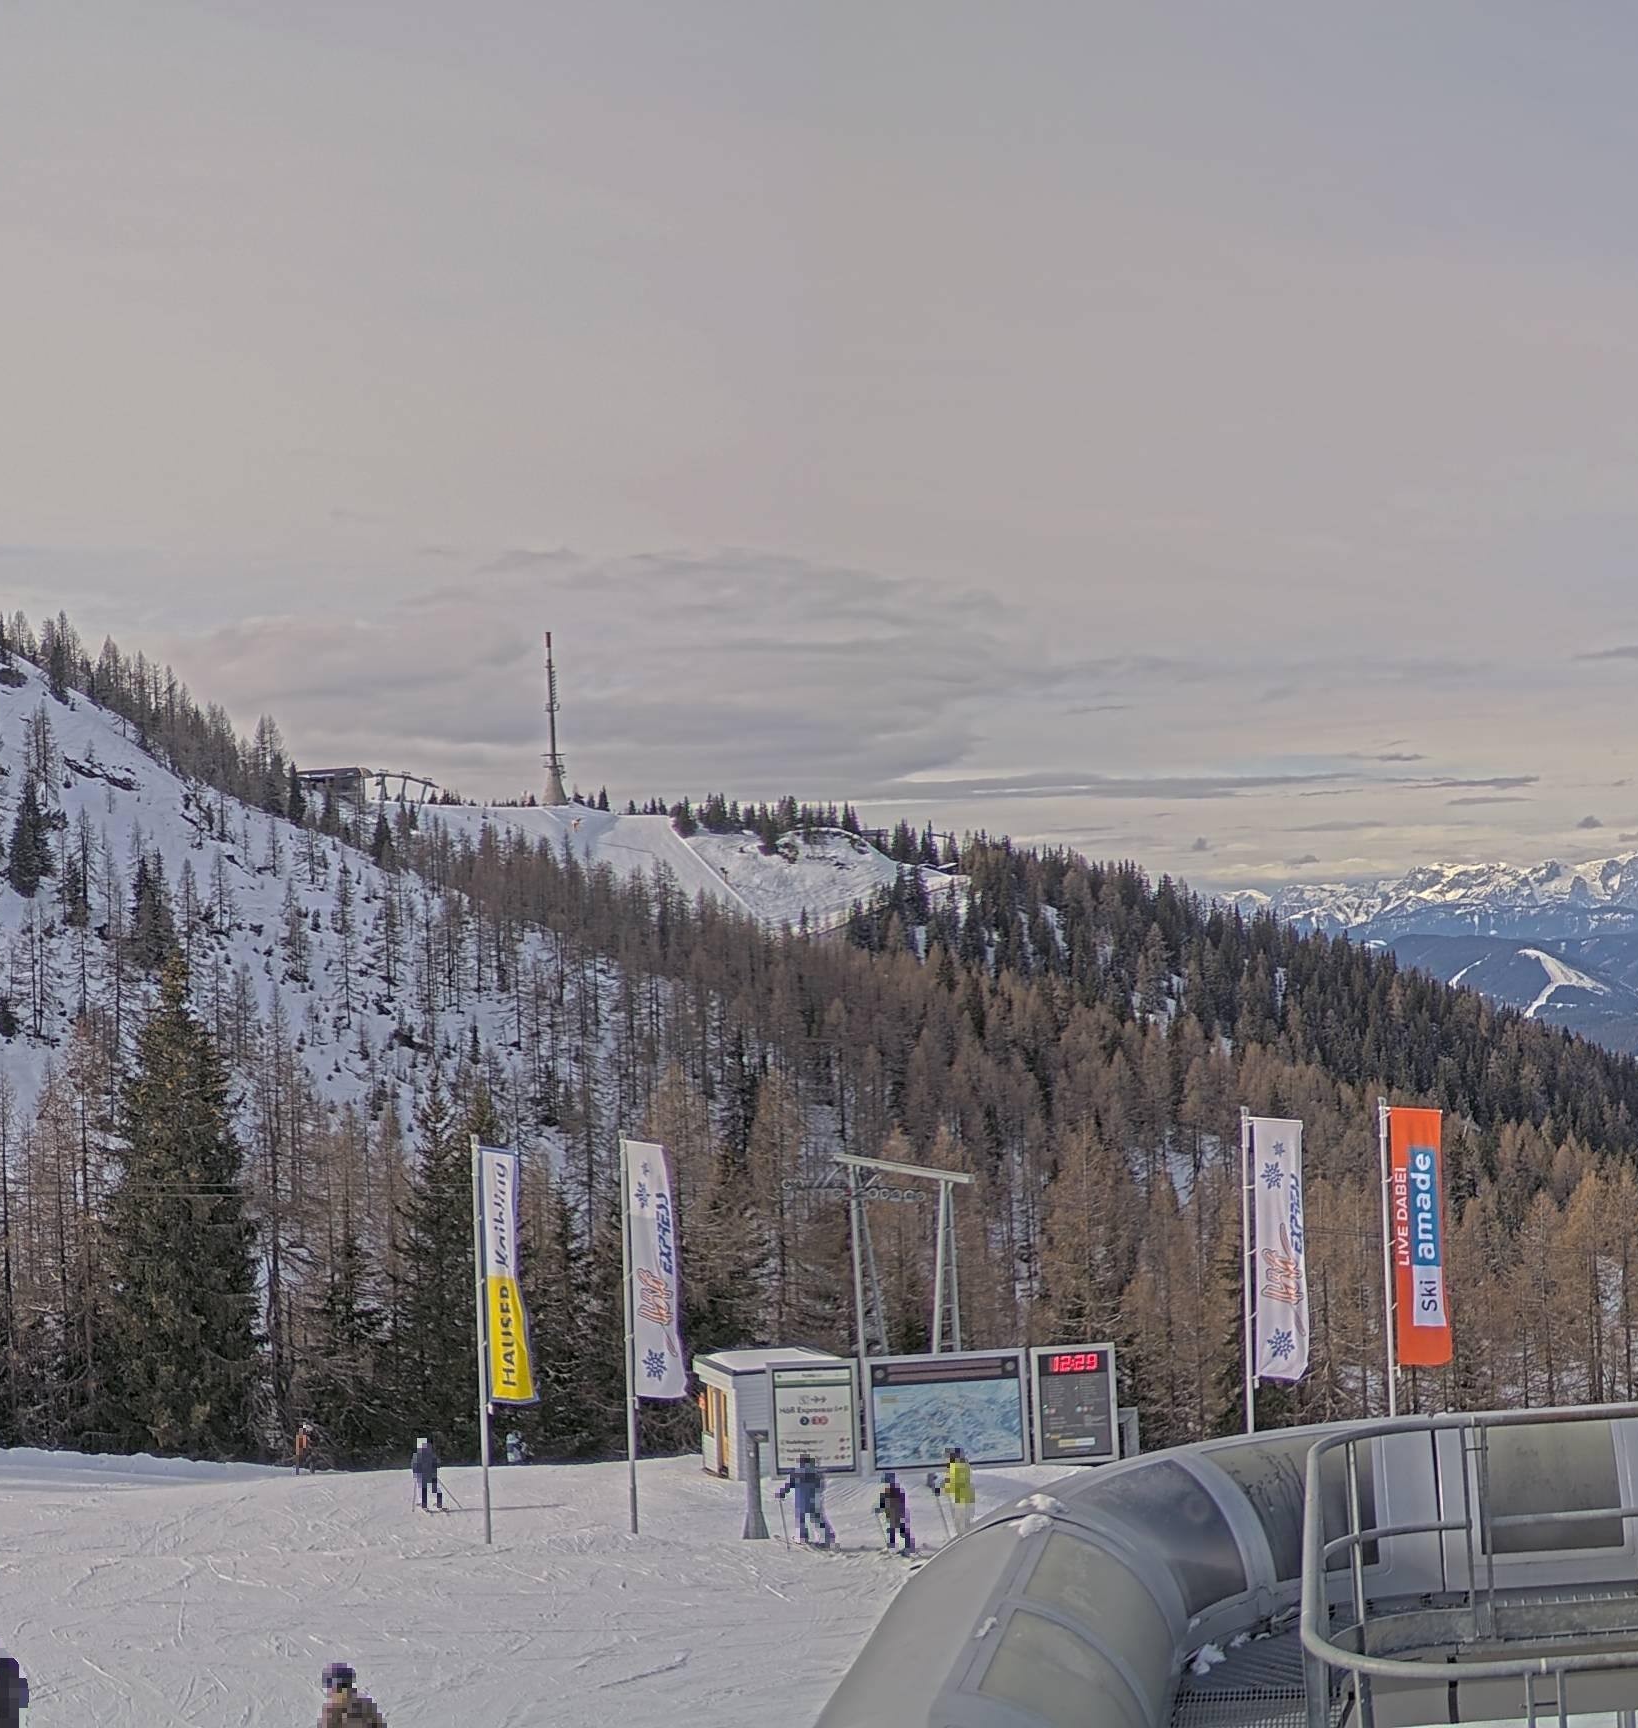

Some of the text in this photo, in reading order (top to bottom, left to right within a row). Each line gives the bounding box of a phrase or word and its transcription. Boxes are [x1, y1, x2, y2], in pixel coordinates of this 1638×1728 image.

[1394, 1167, 1410, 1266] LIVE DABEI
[1421, 1279, 1437, 1312] Ski
[1050, 1353, 1099, 1373] 12:29
